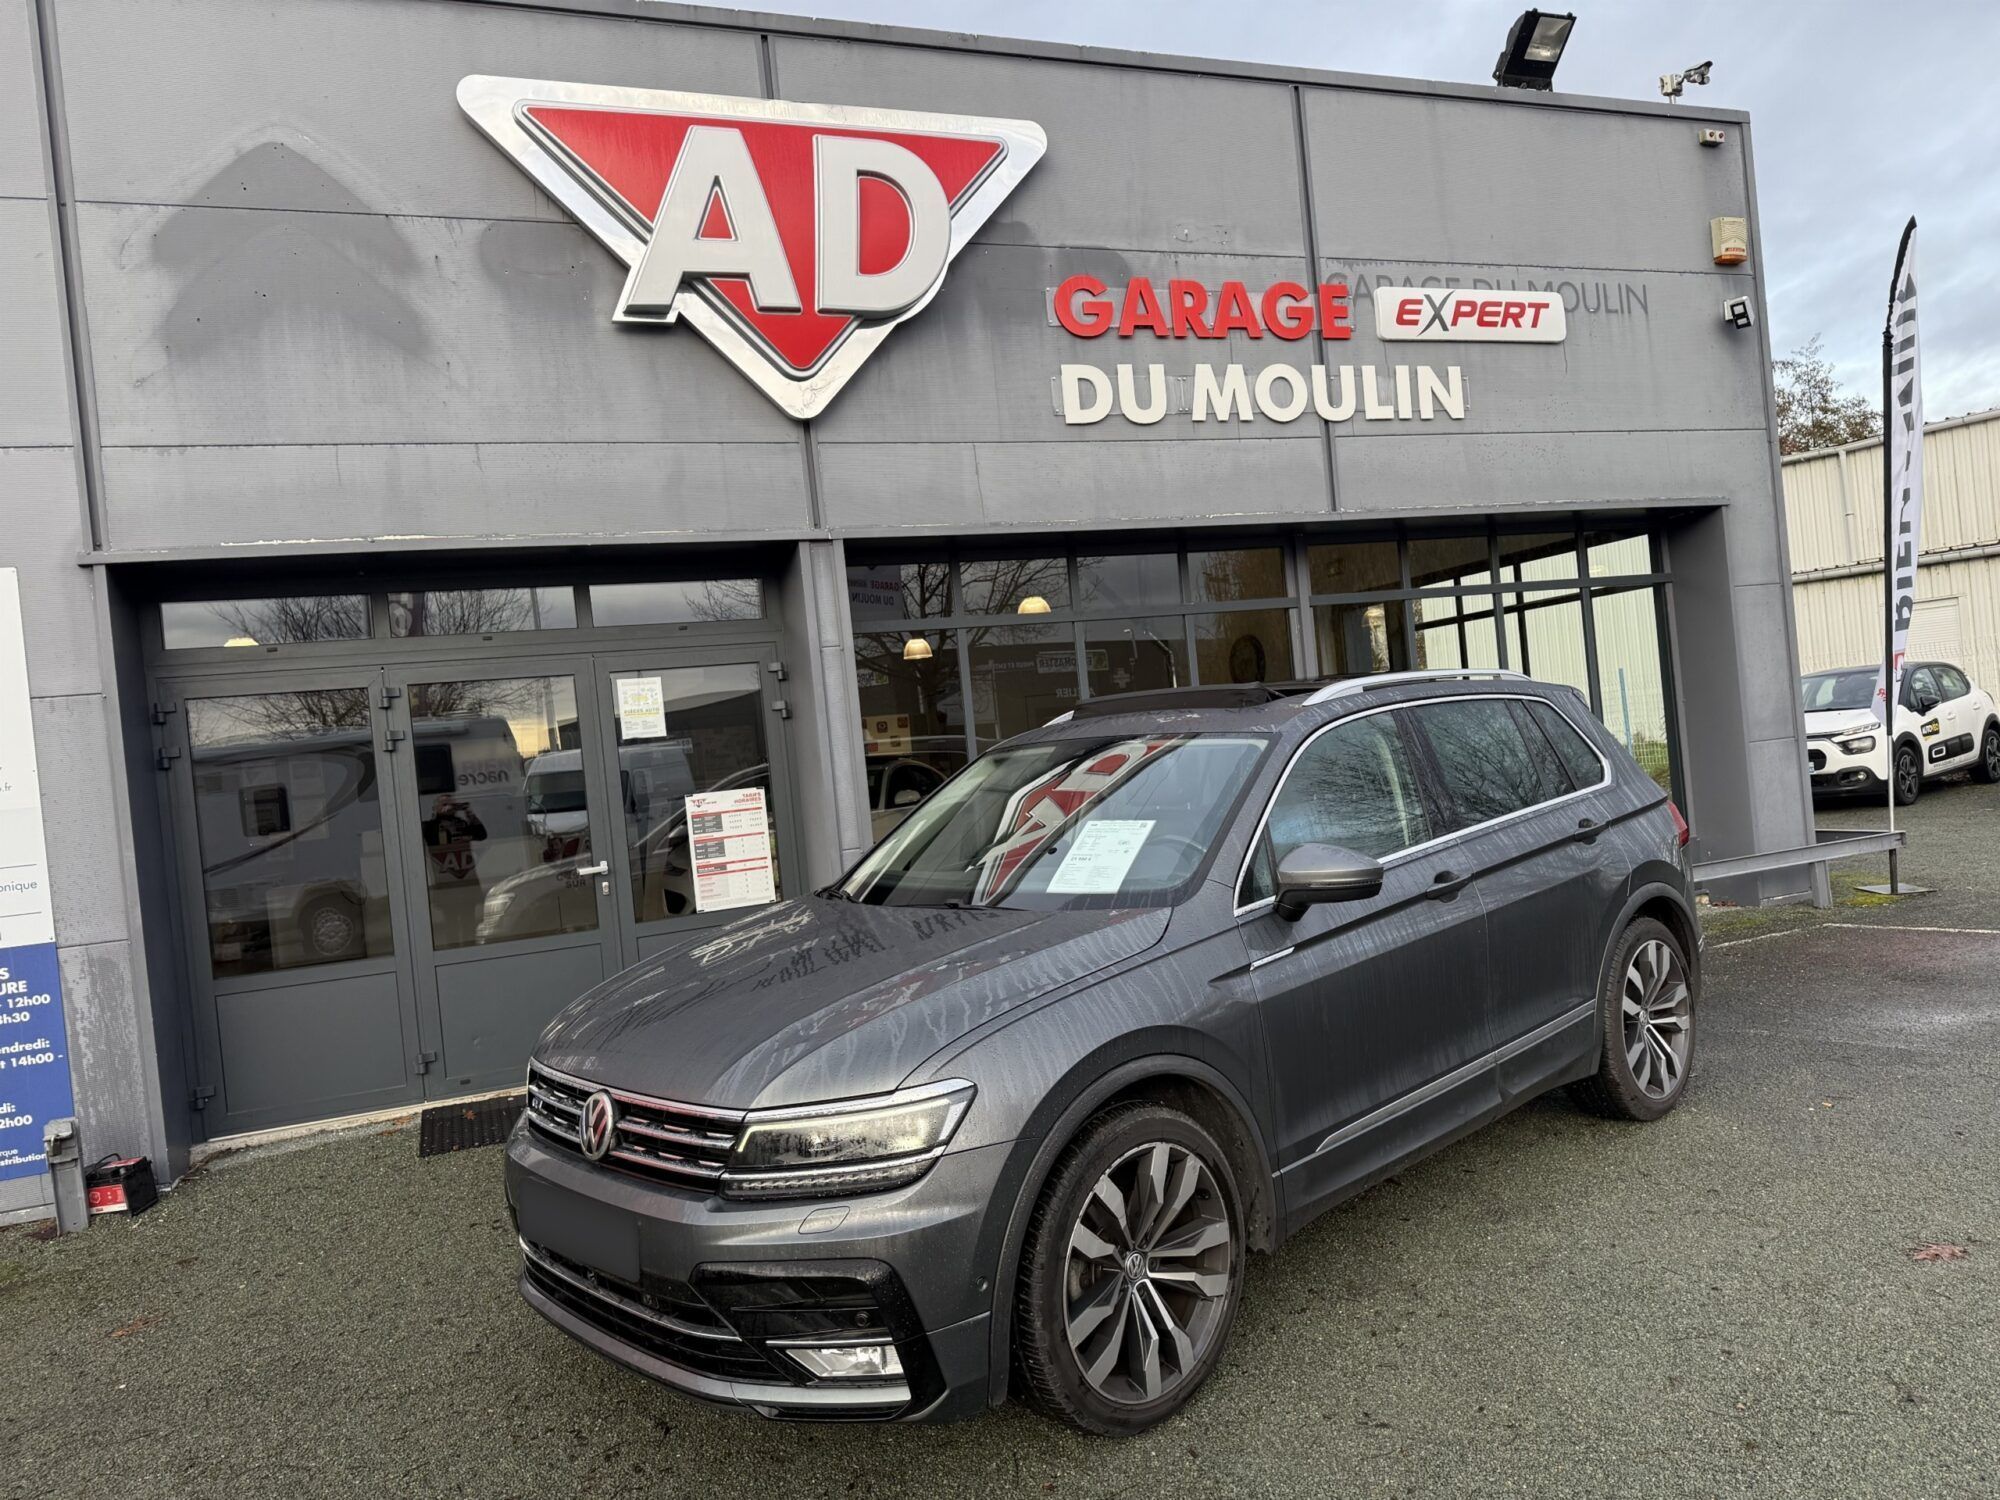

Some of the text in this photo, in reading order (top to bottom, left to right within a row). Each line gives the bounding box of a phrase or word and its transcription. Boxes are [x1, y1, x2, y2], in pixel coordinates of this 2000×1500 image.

[622, 124, 952, 320] AD
[1053, 274, 1352, 340] GARAGE
[1395, 289, 1551, 337] EXPERT
[1060, 363, 1465, 425] DU MOULIN
[7, 993, 51, 1009] 12h00
[10, 1052, 54, 1068] 14h00
